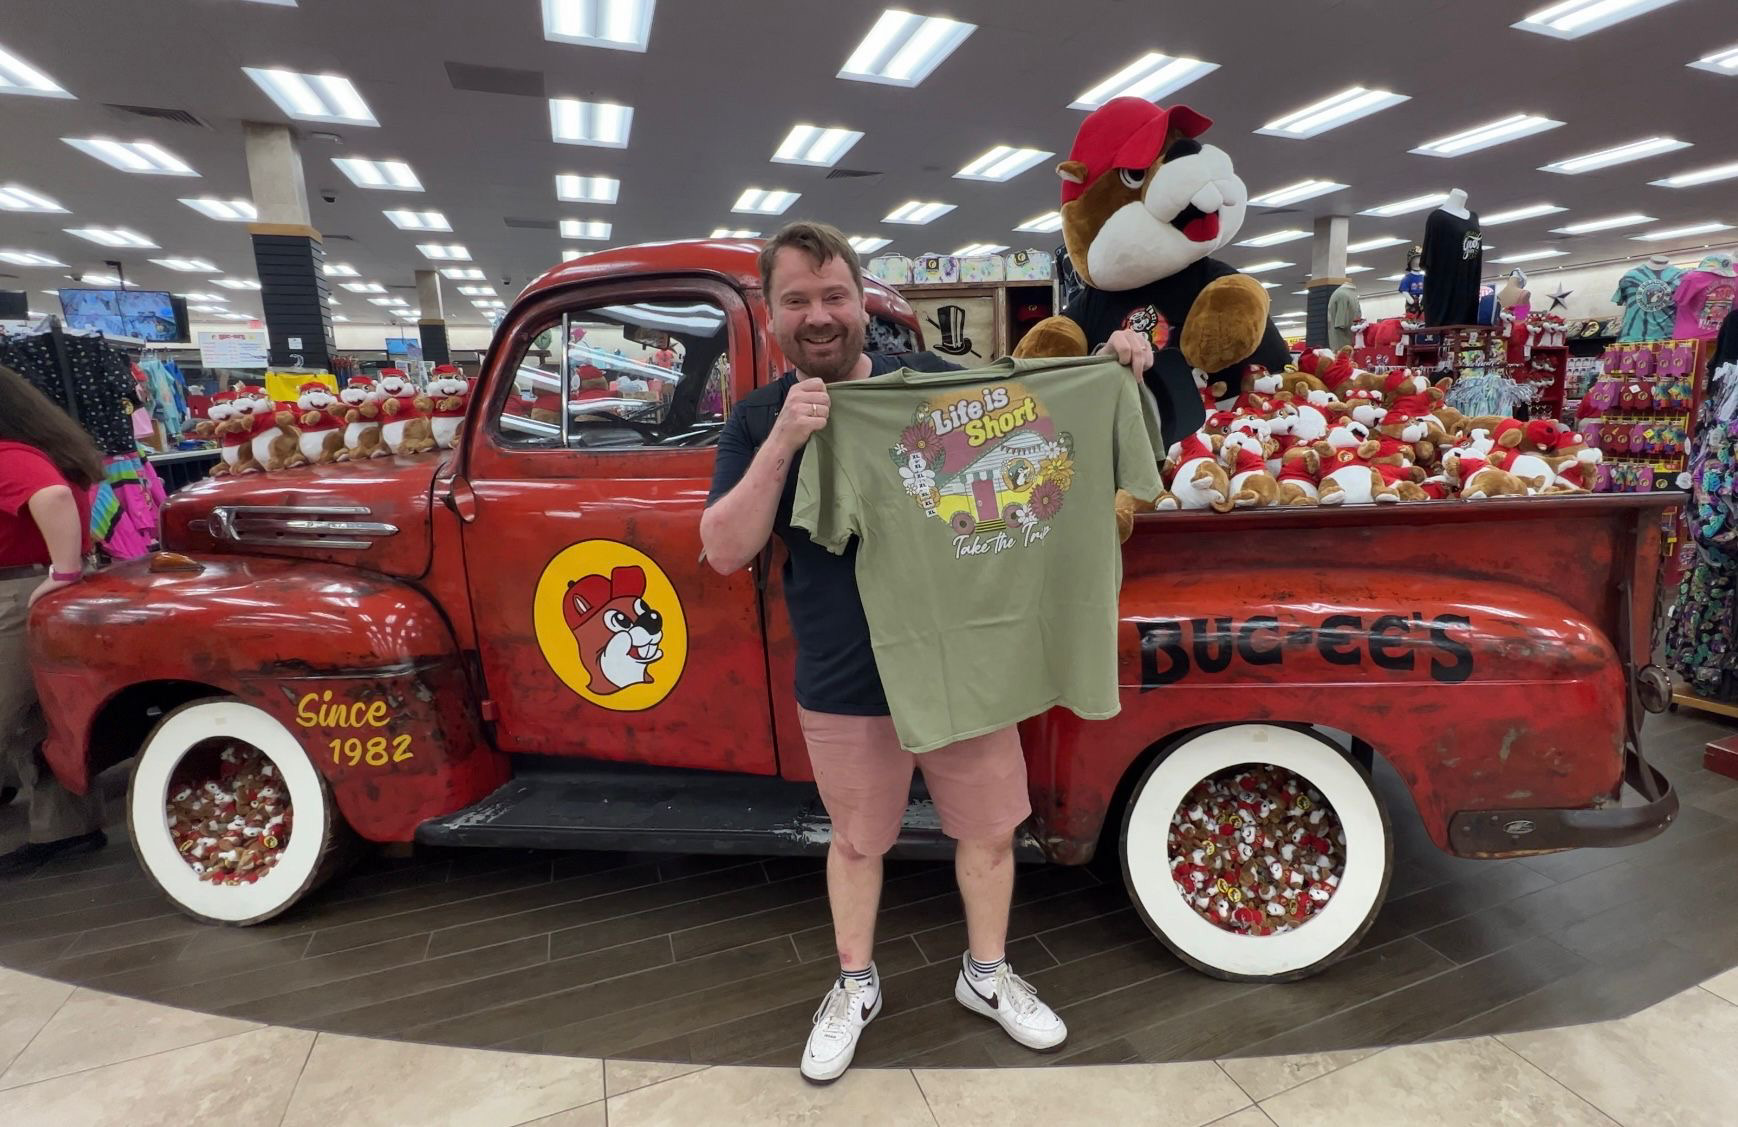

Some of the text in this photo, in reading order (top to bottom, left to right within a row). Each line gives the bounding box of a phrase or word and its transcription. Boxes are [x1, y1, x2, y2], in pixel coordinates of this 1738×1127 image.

[931, 387, 1010, 436] Life is
[964, 396, 1038, 447] Short
[952, 520, 1052, 559] Take the Trip
[1137, 612, 1473, 692] BUC-EE'S
[295, 690, 391, 728] Since
[328, 734, 414, 767] 1982
